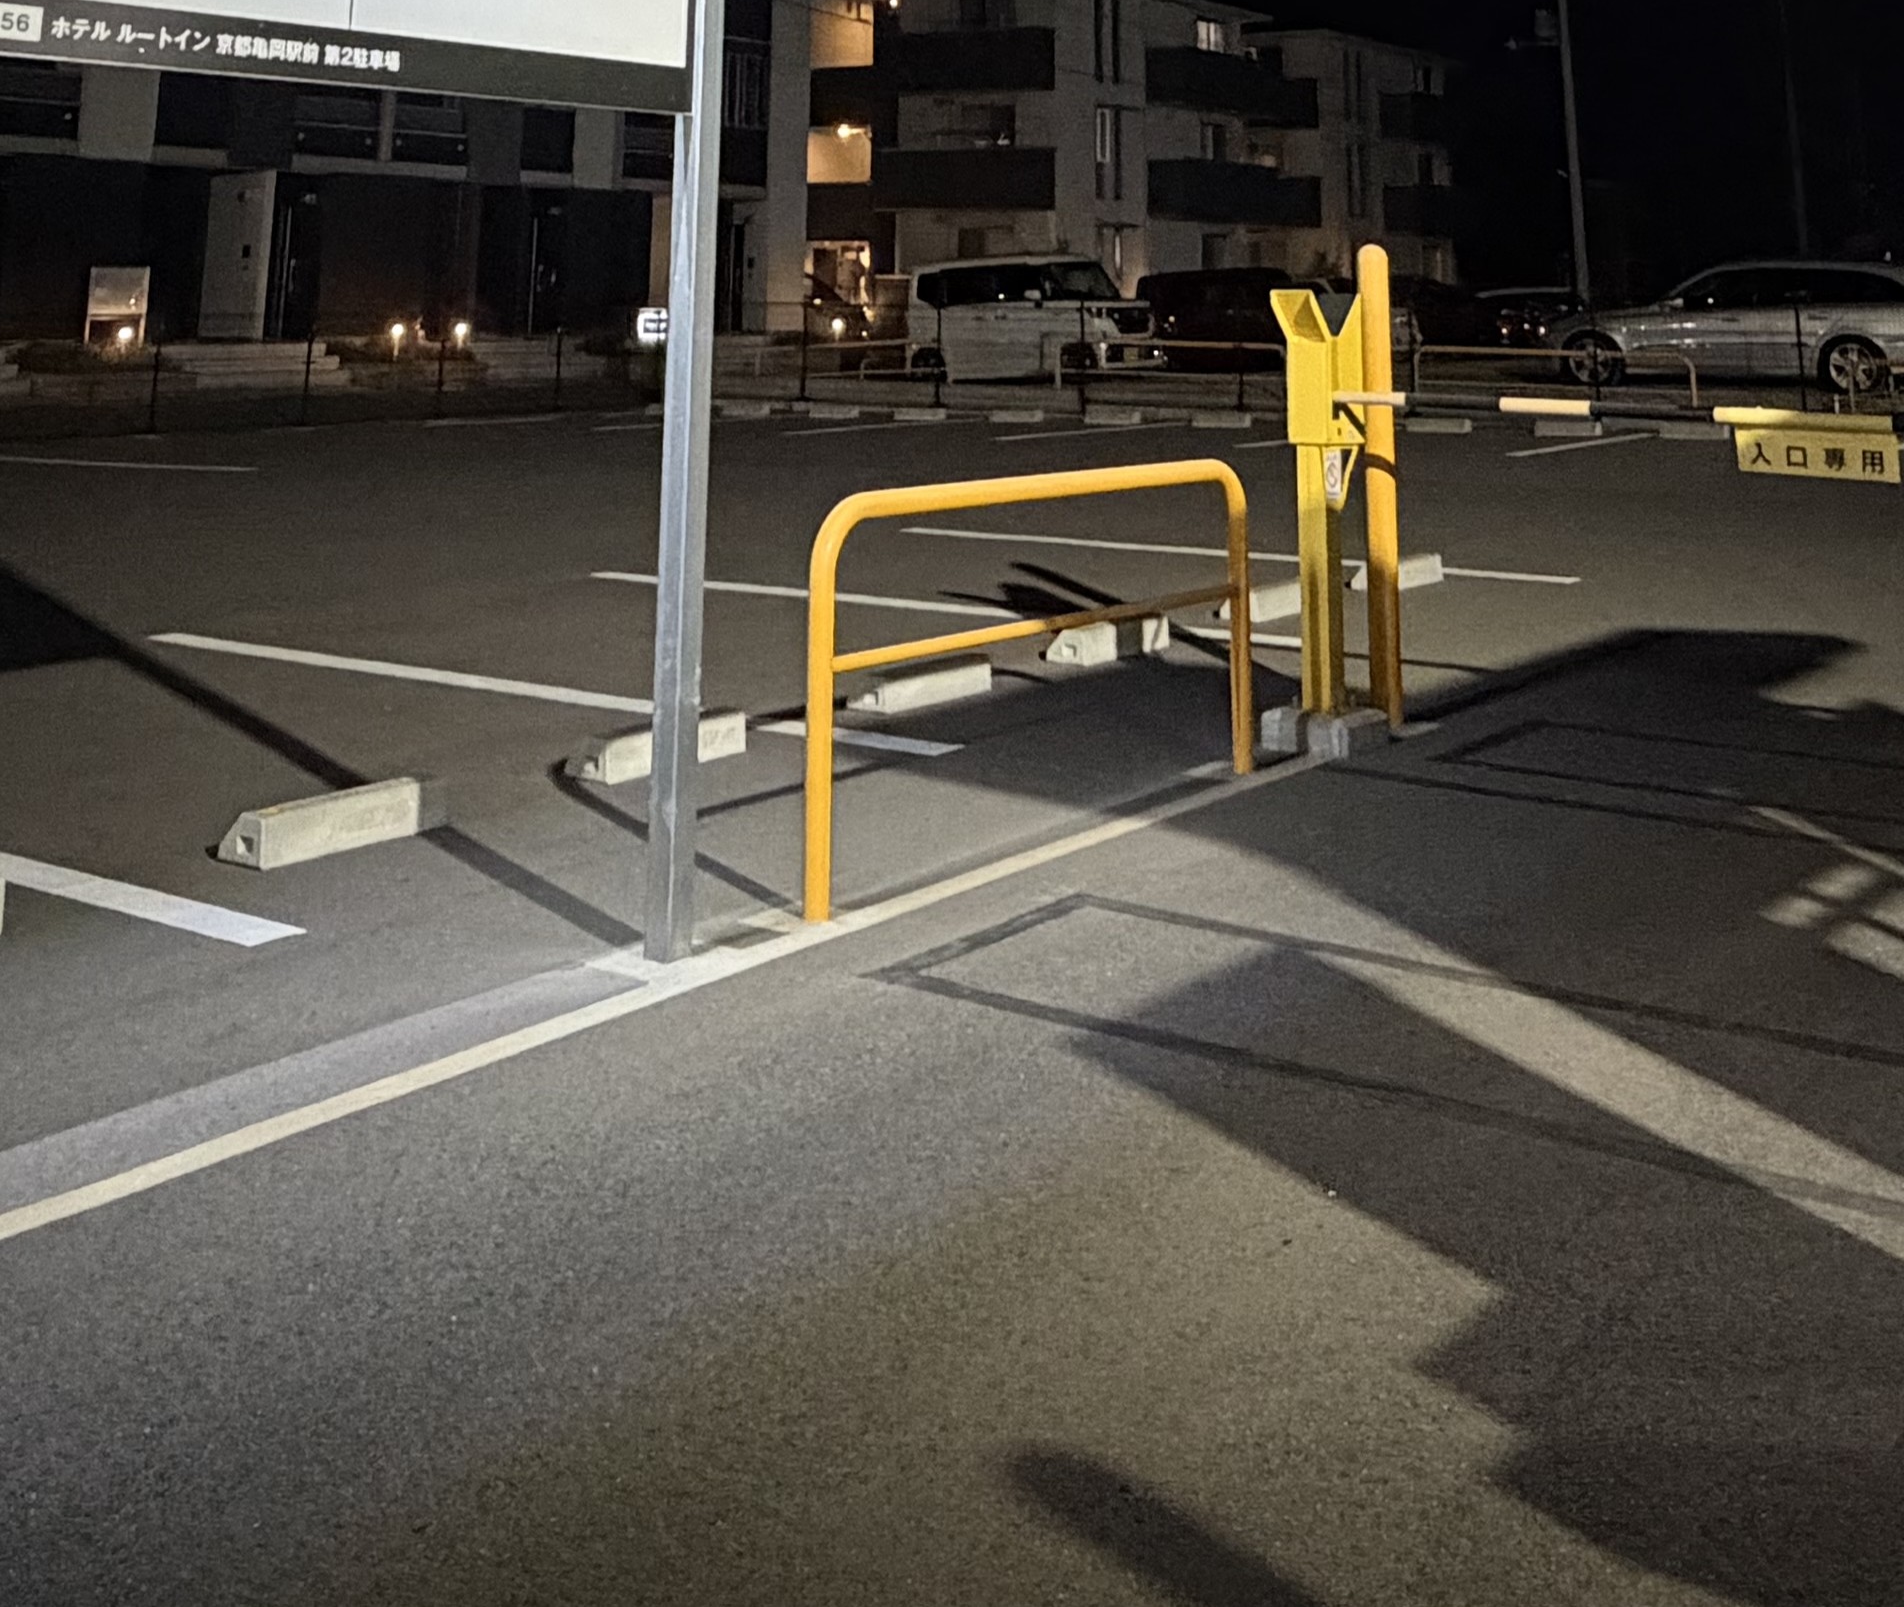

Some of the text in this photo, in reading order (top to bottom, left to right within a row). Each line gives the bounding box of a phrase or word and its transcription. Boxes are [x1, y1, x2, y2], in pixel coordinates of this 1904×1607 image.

[50, 16, 401, 72] ホテル ルートイン 京都亀岡駅前 第2駐車場
[1751, 442, 1885, 474] 入口専用
